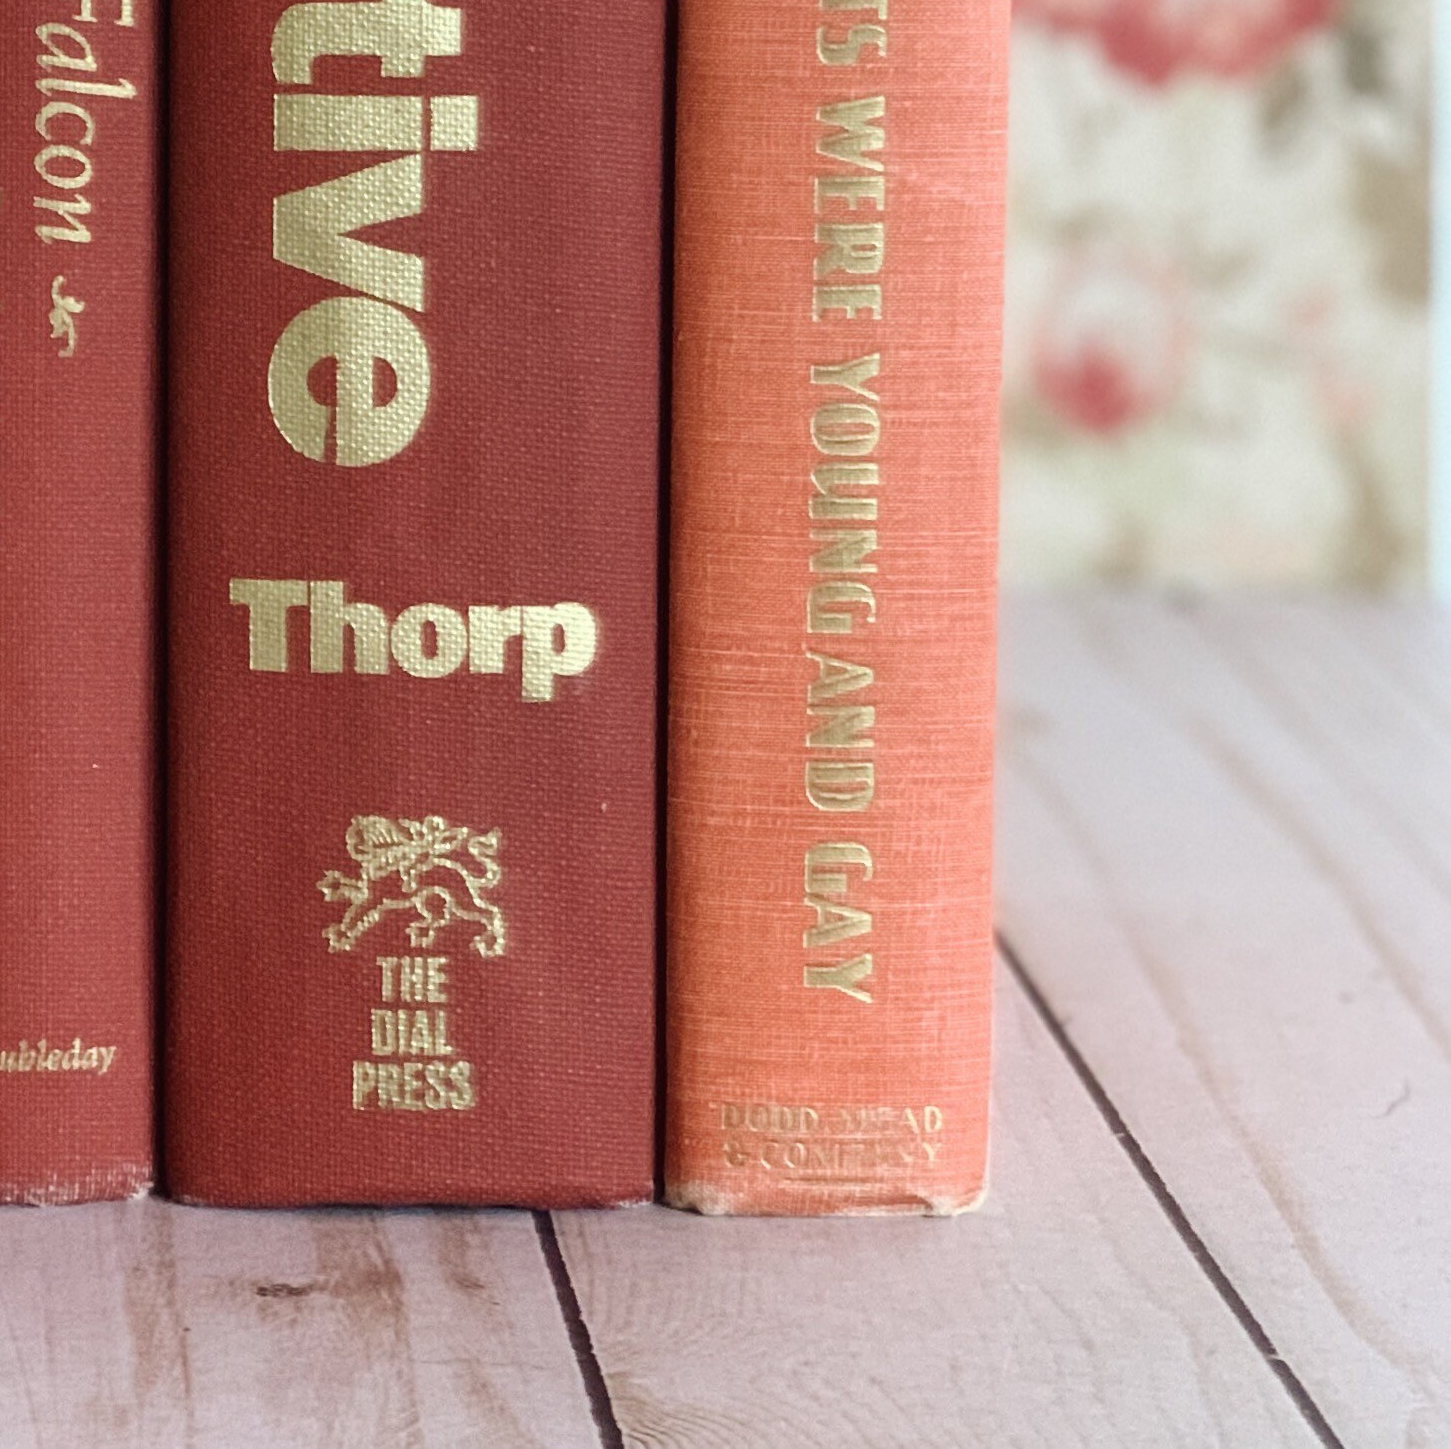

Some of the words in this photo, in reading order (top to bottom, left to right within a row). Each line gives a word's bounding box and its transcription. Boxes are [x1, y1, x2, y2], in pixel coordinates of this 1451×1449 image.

[812, 95, 887, 323] WERE
[806, 352, 882, 634] YOUNG
[229, 577, 598, 704] Thorp
[805, 650, 876, 812] AND
[376, 955, 450, 1004] THE
[802, 841, 874, 1004] GAY
[352, 1059, 476, 1112] PRESS
[370, 1008, 453, 1056] DIAL
